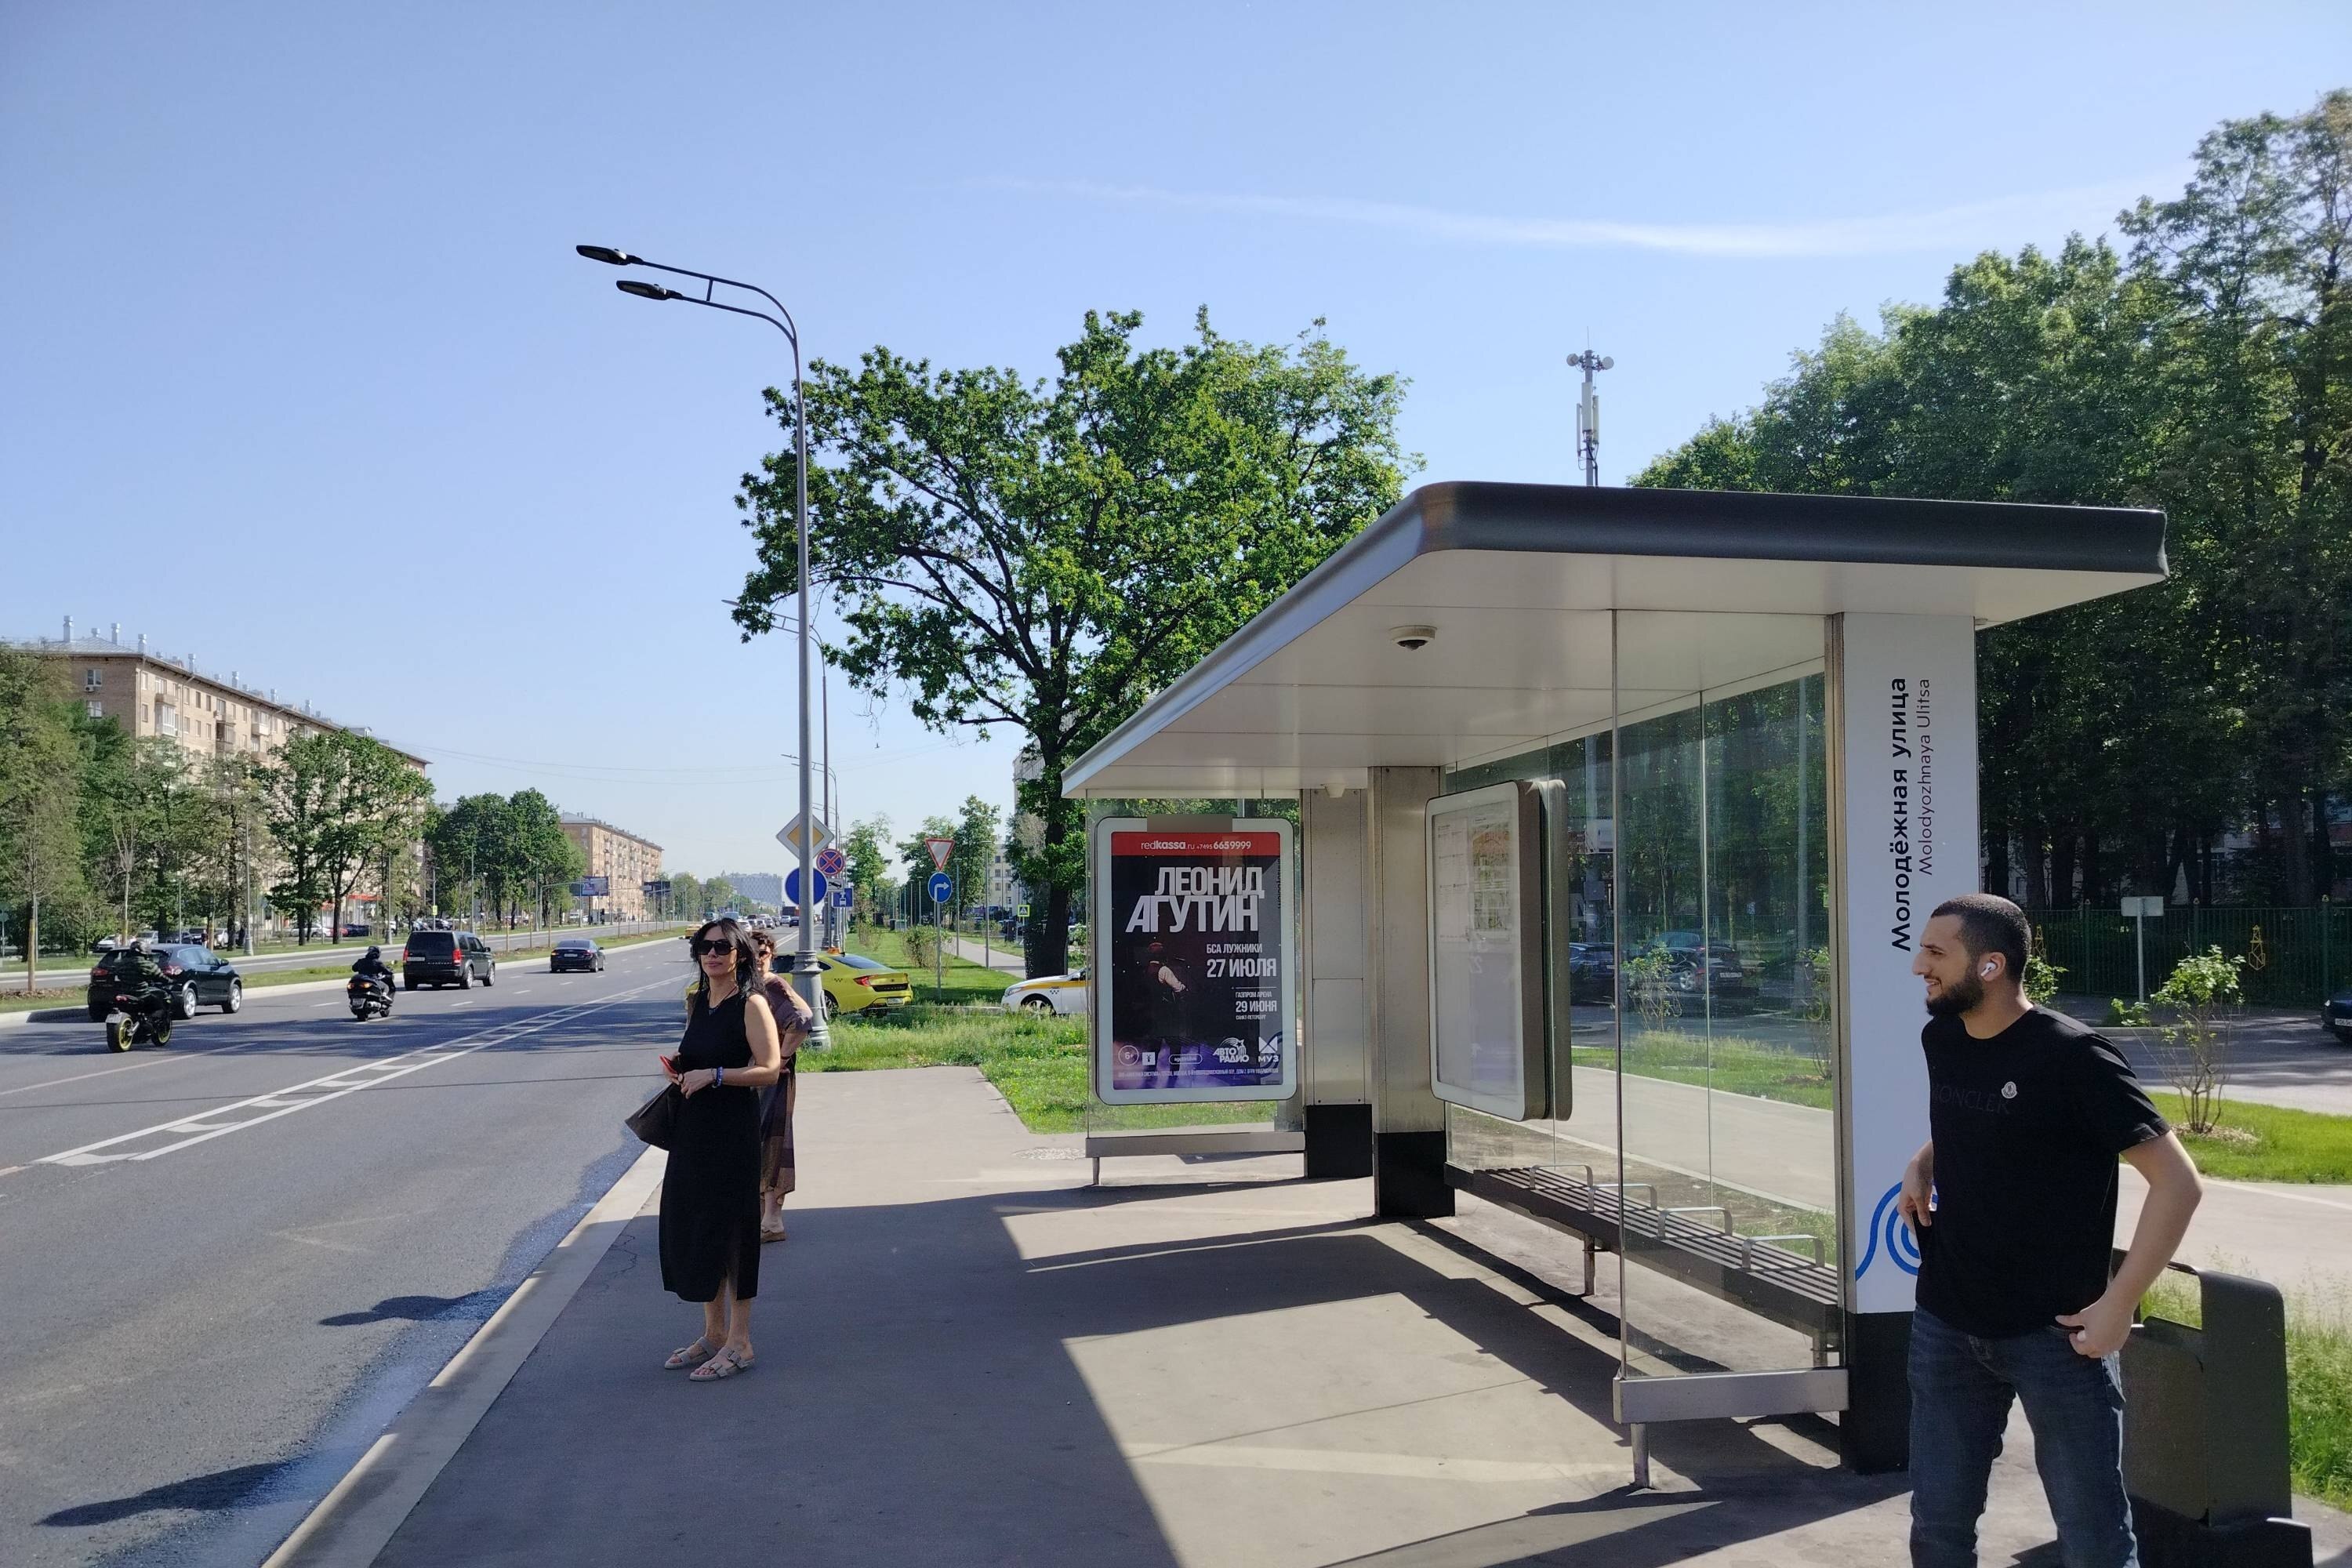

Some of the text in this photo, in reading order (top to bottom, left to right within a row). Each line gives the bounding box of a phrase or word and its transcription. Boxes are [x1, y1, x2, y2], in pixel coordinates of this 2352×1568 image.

[1917, 679, 1935, 876] Molodyozhnaya Ulitsa
[1889, 678, 1912, 952] Молодёжная улица
[1155, 866, 1265, 899] ЛЕОНИД
[1125, 895, 1259, 933] АГУТИН
[1206, 942, 1263, 954] БСА ЛУЖНИКИ
[1207, 958, 1276, 978] 27 ИЮЛЯ
[1235, 1000, 1277, 1013] 29 ИЮНЯ
[1124, 1051, 1134, 1060] 6+
[1212, 1047, 1237, 1056] АВТО
[1219, 1054, 1250, 1063] РАДИО
